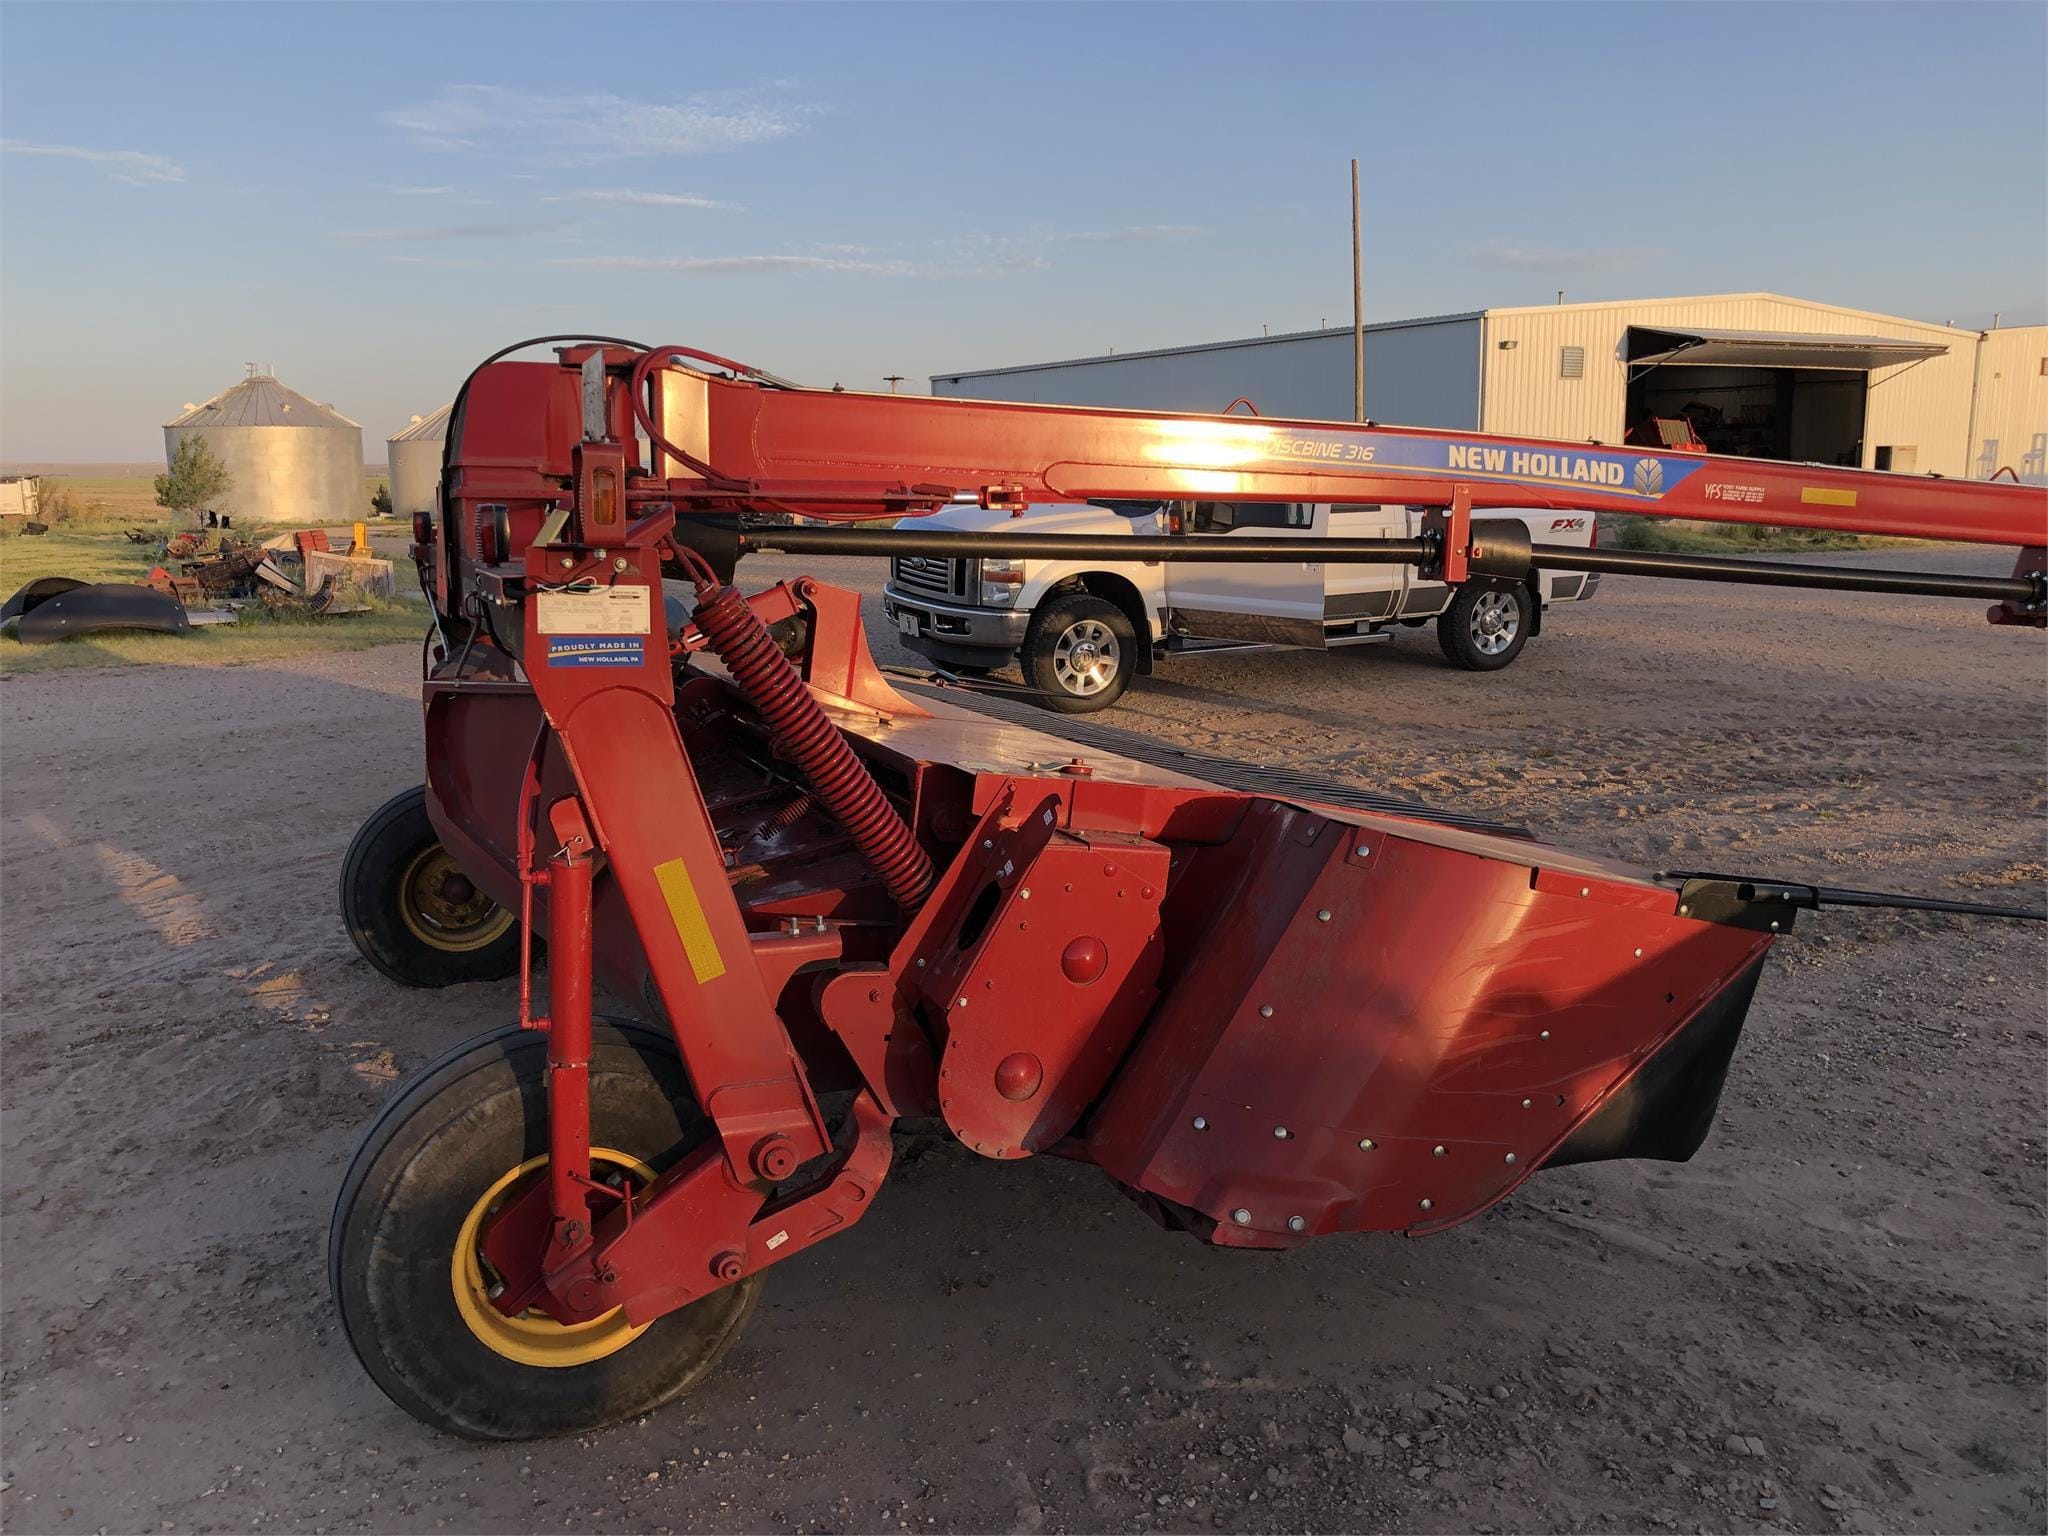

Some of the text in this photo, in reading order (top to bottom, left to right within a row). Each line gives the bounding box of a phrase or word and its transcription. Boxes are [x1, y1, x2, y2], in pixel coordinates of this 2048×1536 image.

[1345, 445, 1375, 460] 316
[1449, 445, 1625, 485] NEW HOLLAND
[1705, 483, 1722, 499] YFS
[1550, 518, 1585, 529] FX4
[551, 643, 595, 652] PROUDLY
